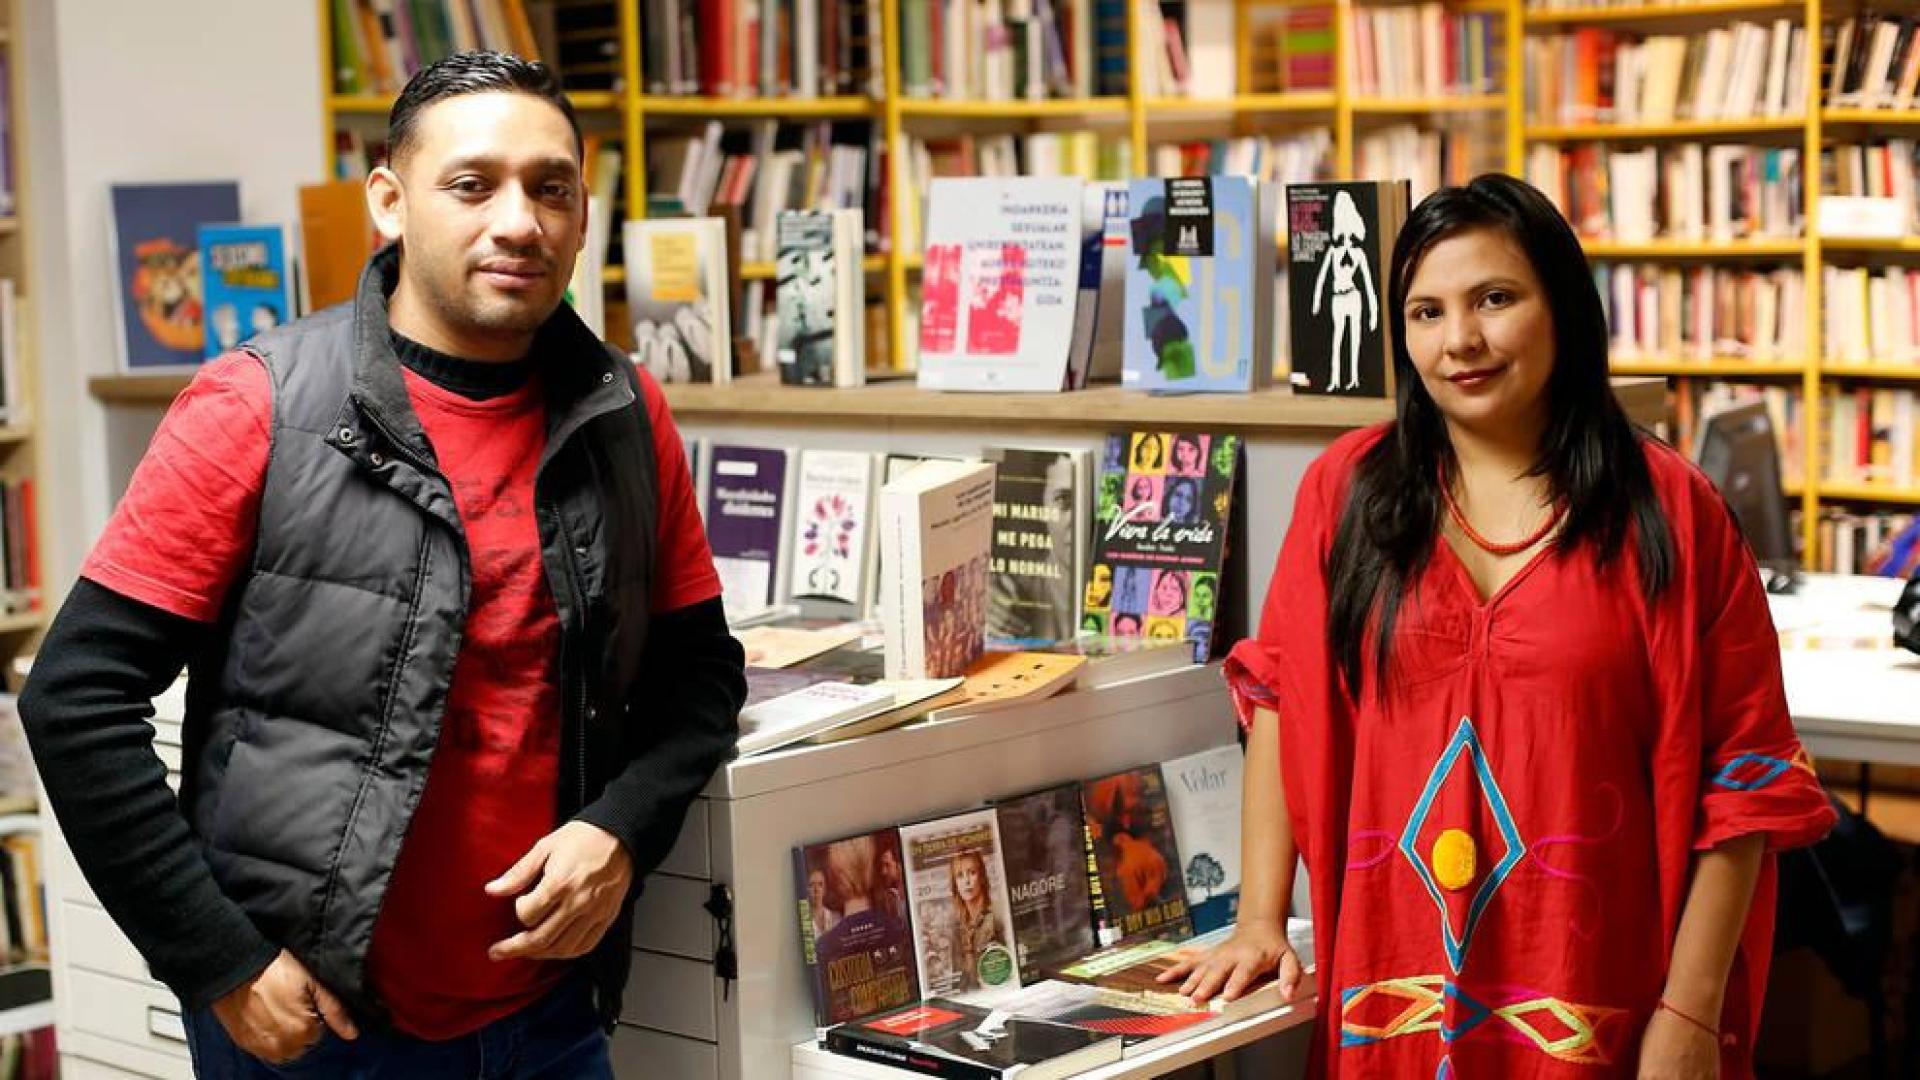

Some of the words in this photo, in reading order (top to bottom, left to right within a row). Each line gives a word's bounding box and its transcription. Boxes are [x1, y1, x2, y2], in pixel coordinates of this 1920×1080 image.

[1011, 505, 1061, 522] MARIDO
[1104, 500, 1154, 542] Viva
[1151, 511, 1171, 542] la
[1173, 515, 1214, 544] vida
[997, 530, 1017, 546] ME
[1020, 531, 1054, 549] PEGA
[990, 557, 1005, 573] LO
[1008, 558, 1061, 579] NORMAL
[1179, 767, 1227, 793] Volar
[1010, 873, 1067, 902] NAGORE
